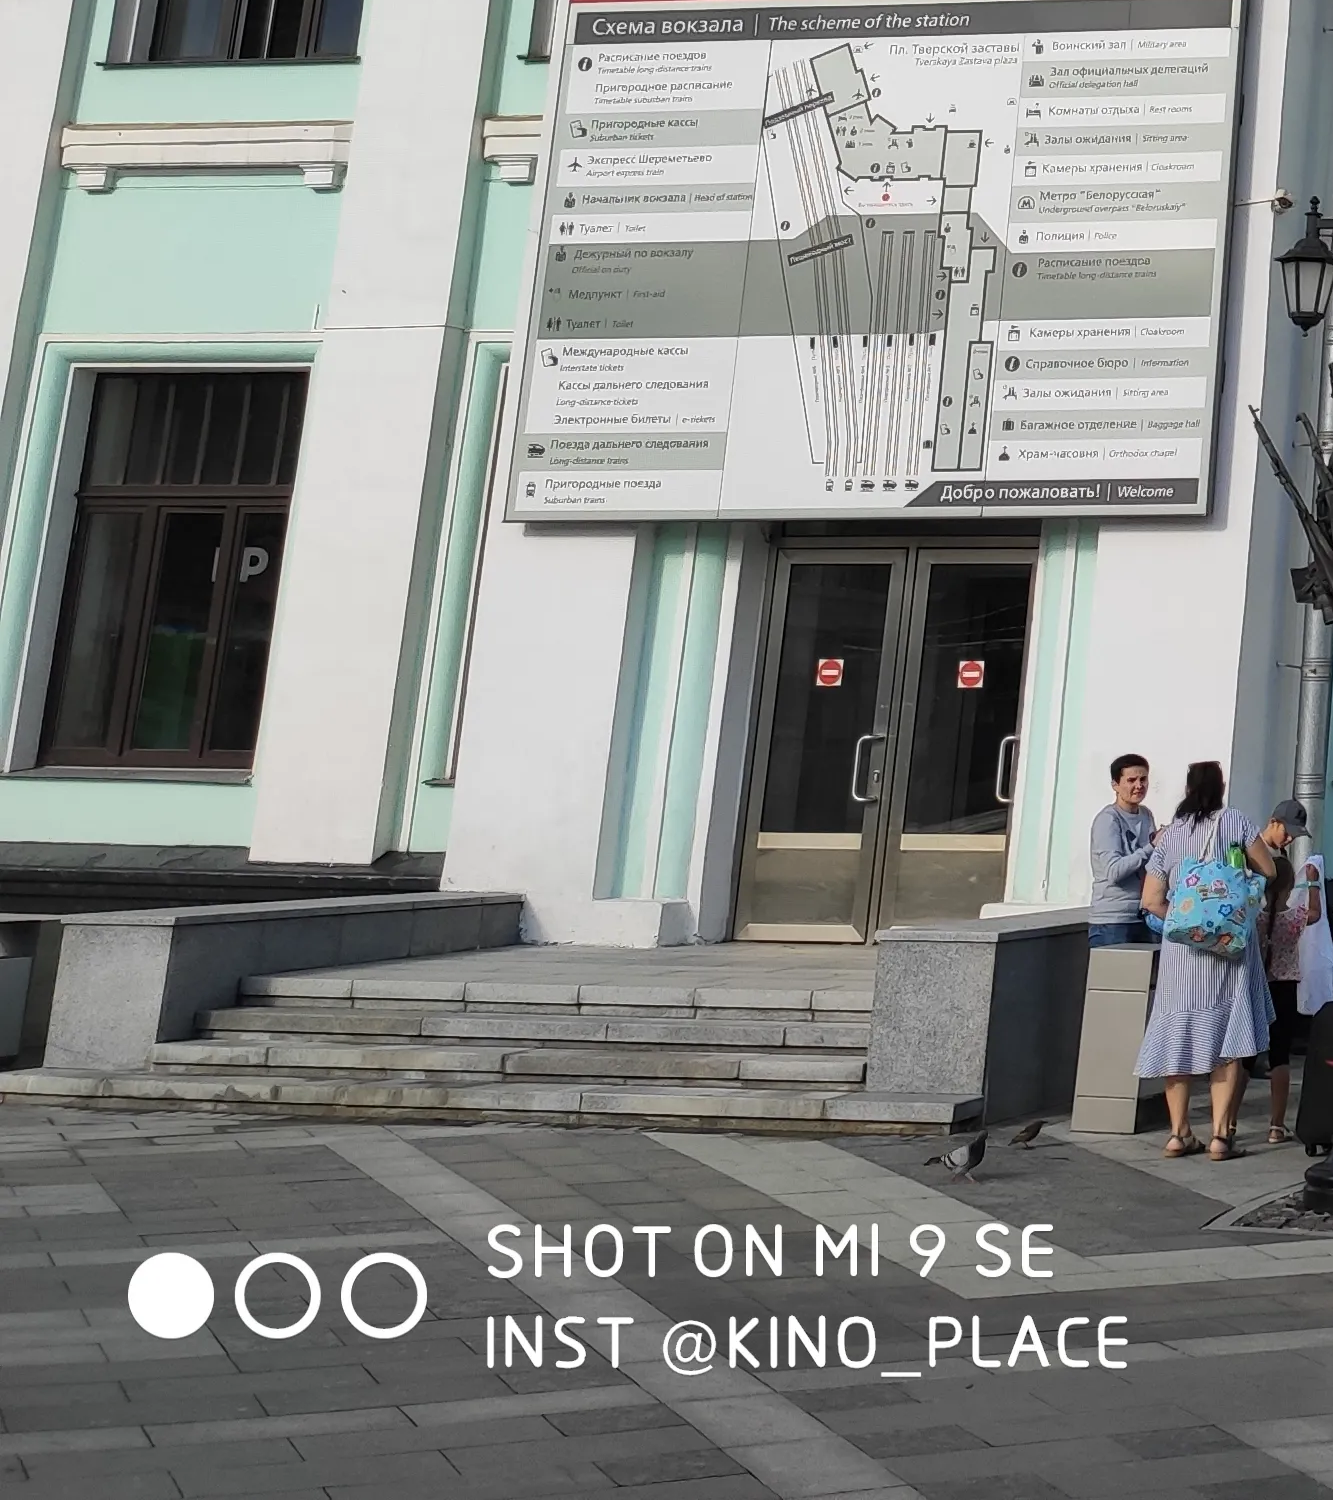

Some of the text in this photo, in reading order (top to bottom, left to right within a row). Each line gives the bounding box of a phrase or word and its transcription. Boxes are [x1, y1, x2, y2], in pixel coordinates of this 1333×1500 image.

[592, 16, 744, 37] Схема вокзала
[768, 12, 970, 32] The scheme of the station
[889, 42, 1020, 56] Пл. Тверской заставы
[1052, 39, 1127, 51] Воинский зал
[599, 52, 706, 63] Расписание поездов
[915, 57, 957, 68] Tverskaya
[958, 56, 992, 66] Zastava
[1050, 63, 1209, 78] Зал официальных делегаций
[595, 81, 733, 95] Пригородное расписание
[1049, 105, 1140, 118] Комнаты отдыха
[591, 117, 699, 130] Пригородные кассы
[1044, 134, 1132, 146] Залы ожидания
[587, 154, 713, 167] Экспресс Шереметьево
[1042, 162, 1143, 177] Камеры хранения
[582, 193, 686, 205] Начальник вокзала
[1039, 190, 1078, 203] Метро
[579, 223, 614, 235] Туалет
[1036, 231, 1085, 243] Полиция
[1094, 231, 1118, 241] Police
[573, 249, 694, 262] Дежурный по вокзалу
[1038, 256, 1151, 269] Расписание поездов
[568, 289, 623, 301] Медпункт
[566, 318, 602, 331] Туалет
[612, 320, 634, 329] Toilet
[1029, 326, 1131, 340] Камеры хранения
[562, 346, 689, 358] Международные кассы
[559, 363, 624, 372] Interstate tickets
[1025, 356, 1129, 371] Справочное бюро
[558, 380, 709, 391] Кассы дальнего следования
[1022, 388, 1112, 399] Залы ожидания
[553, 413, 671, 427] Электронные билеты
[1020, 419, 1138, 431] Багажное отделение
[1185, 418, 1201, 428] hall
[550, 439, 709, 450] Поезда дальнего следования
[1018, 449, 1099, 461] Храм-часовня
[1109, 448, 1178, 459] Orthodox chapel
[544, 478, 662, 491] Пригородные поезда
[940, 483, 1101, 502] Добро пожаловать!
[1117, 485, 1174, 499] Welcome
[543, 495, 606, 504] Suburban trains
